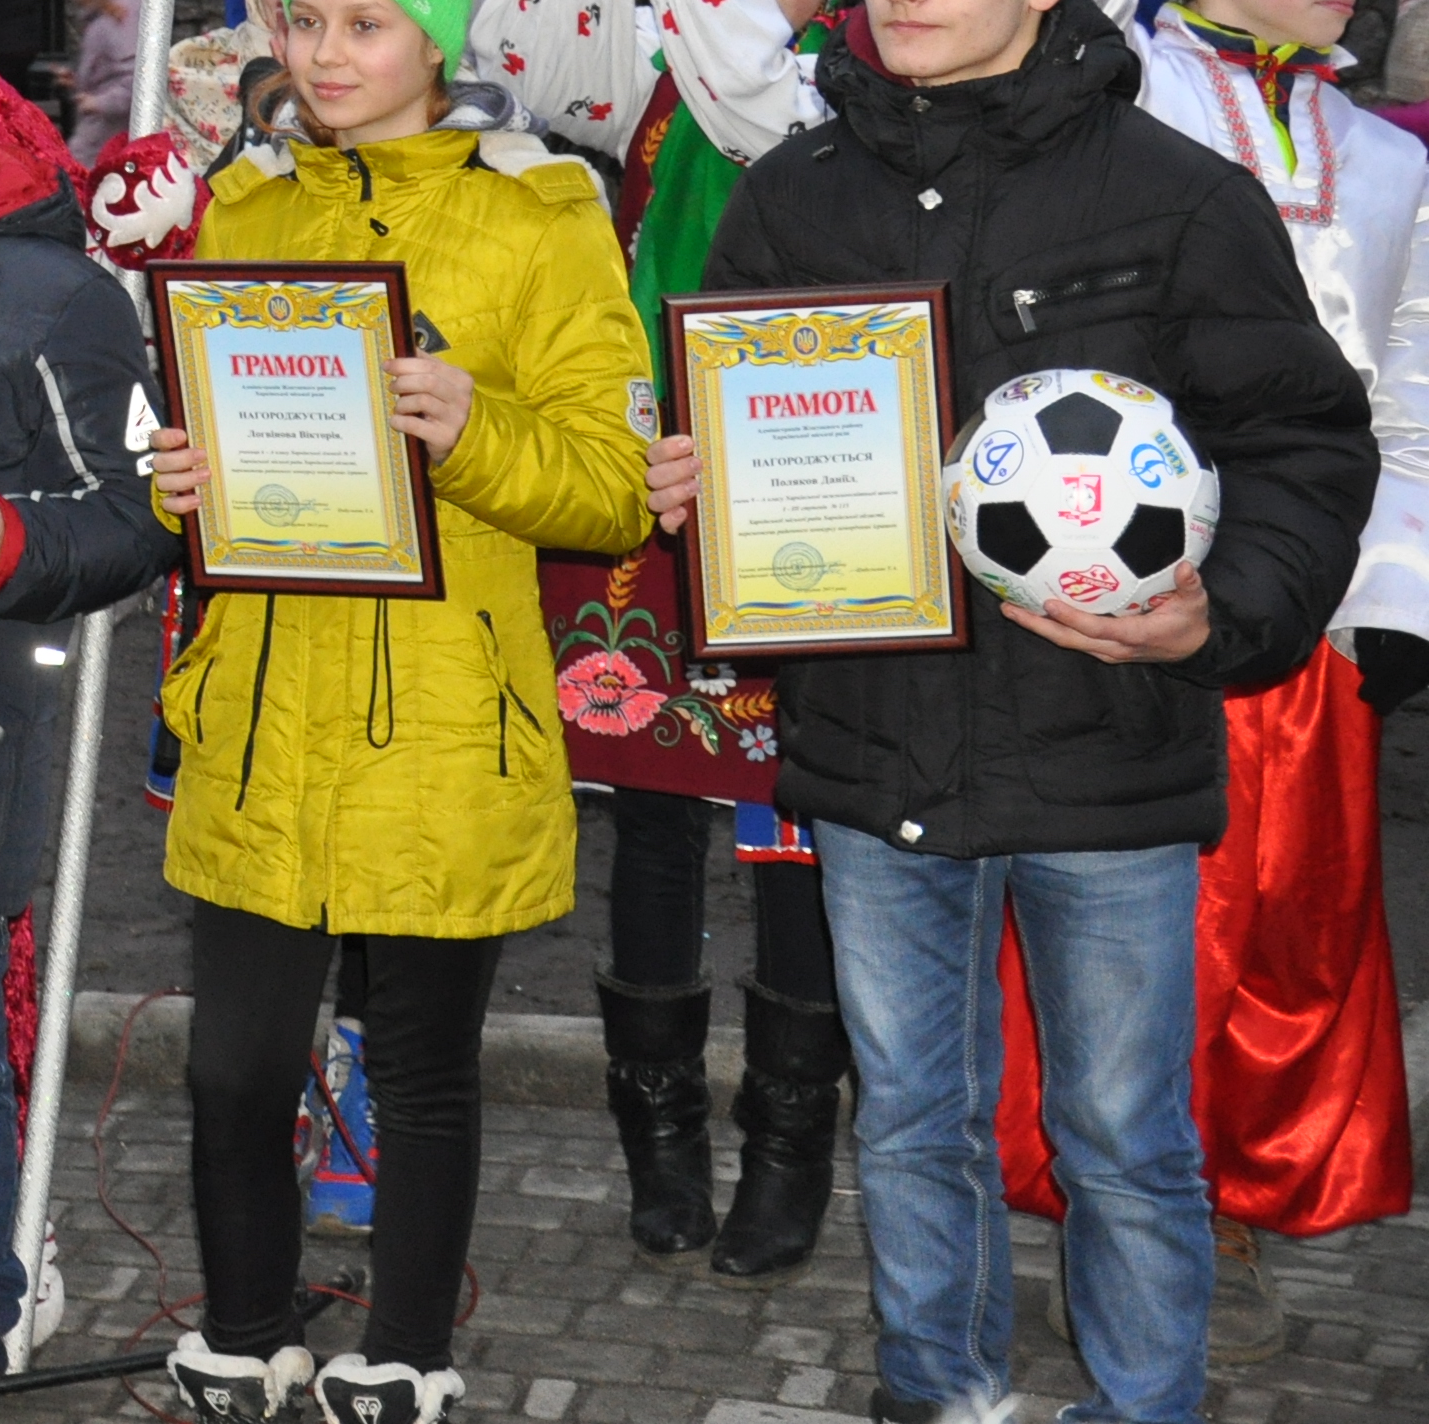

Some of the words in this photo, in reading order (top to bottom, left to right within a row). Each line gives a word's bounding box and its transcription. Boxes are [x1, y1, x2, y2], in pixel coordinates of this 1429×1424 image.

[230, 354, 347, 378] ГРАМОТА
[747, 388, 878, 419] ГРАМОТА
[239, 411, 346, 422] НАГОРОДЖУЄТЬСЯ
[751, 452, 873, 468] НАГОРОДЖУЄТЬСЯ
